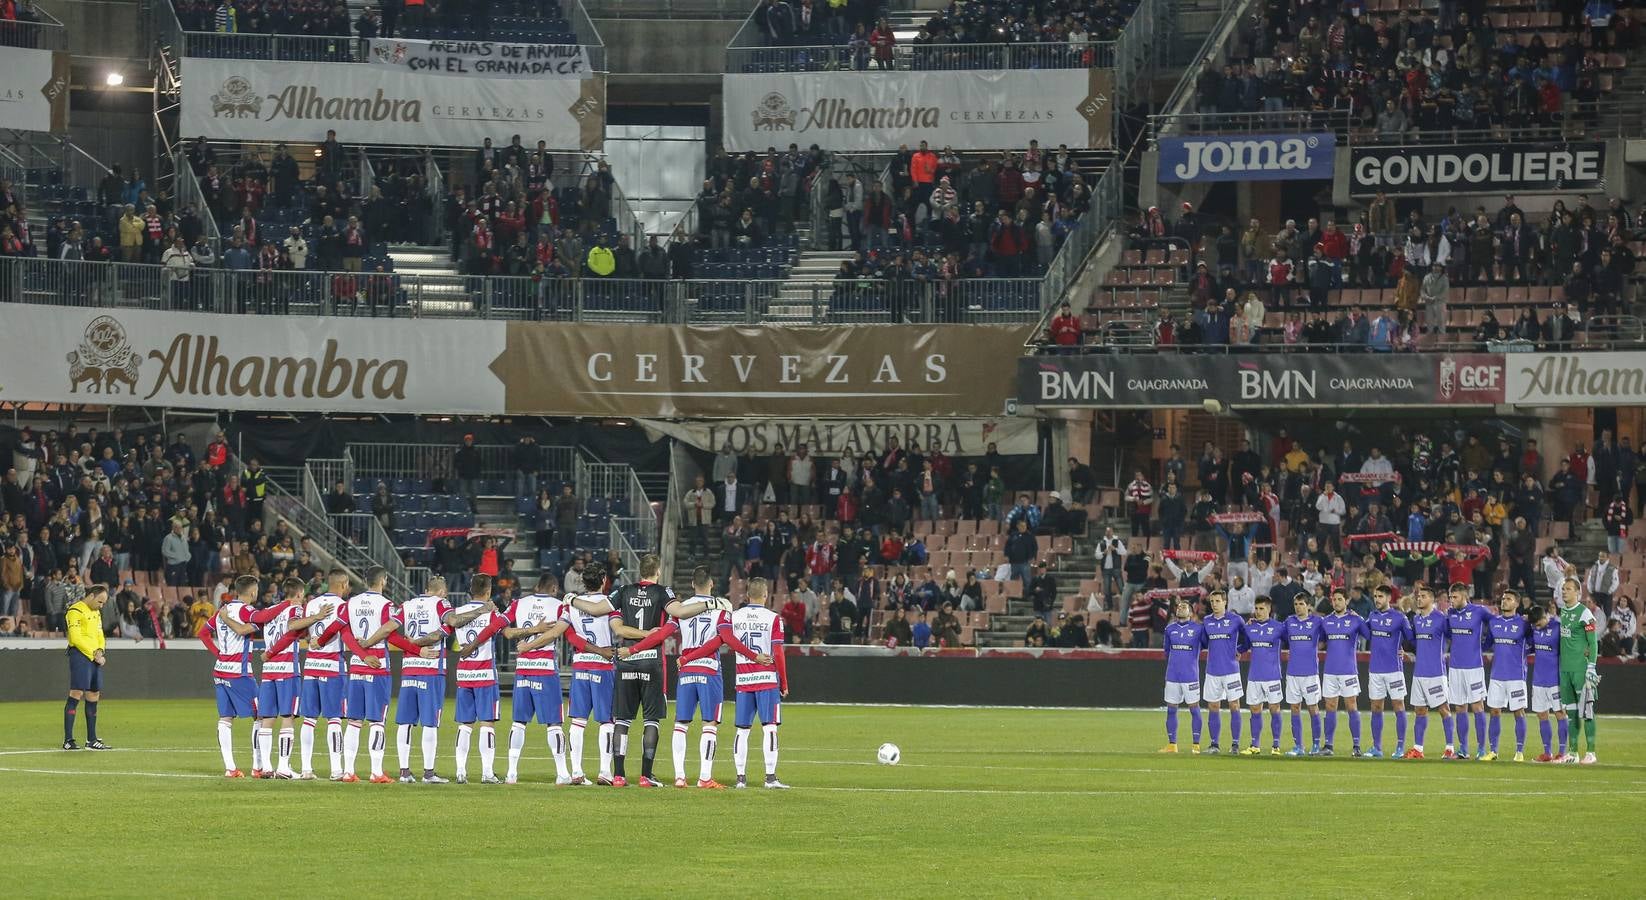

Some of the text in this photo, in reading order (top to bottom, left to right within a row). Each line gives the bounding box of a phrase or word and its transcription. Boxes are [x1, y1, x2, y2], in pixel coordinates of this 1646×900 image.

[407, 57, 440, 71] CON
[446, 57, 468, 73] EL
[474, 60, 552, 74] GRANADA
[501, 46, 524, 58] DE
[265, 85, 544, 122] Alhambra CERVEZAS
[577, 96, 598, 120] SIN
[800, 98, 1056, 133] Alhambra CERVEZAS
[1086, 92, 1108, 117] SIN
[1355, 151, 1599, 186] GONDOLIERE
[144, 332, 408, 400] Alhambra
[587, 352, 947, 384] CERVEZAS
[1460, 366, 1502, 387] GCF
[1519, 355, 1646, 400] Alham
[1039, 371, 1209, 399] BMN CAJAGRANADA
[1238, 370, 1414, 399] BMN CAJAGRANADA
[708, 423, 768, 453] LOS
[635, 608, 644, 630] 1
[689, 617, 712, 647] 17
[740, 632, 762, 655] 15
